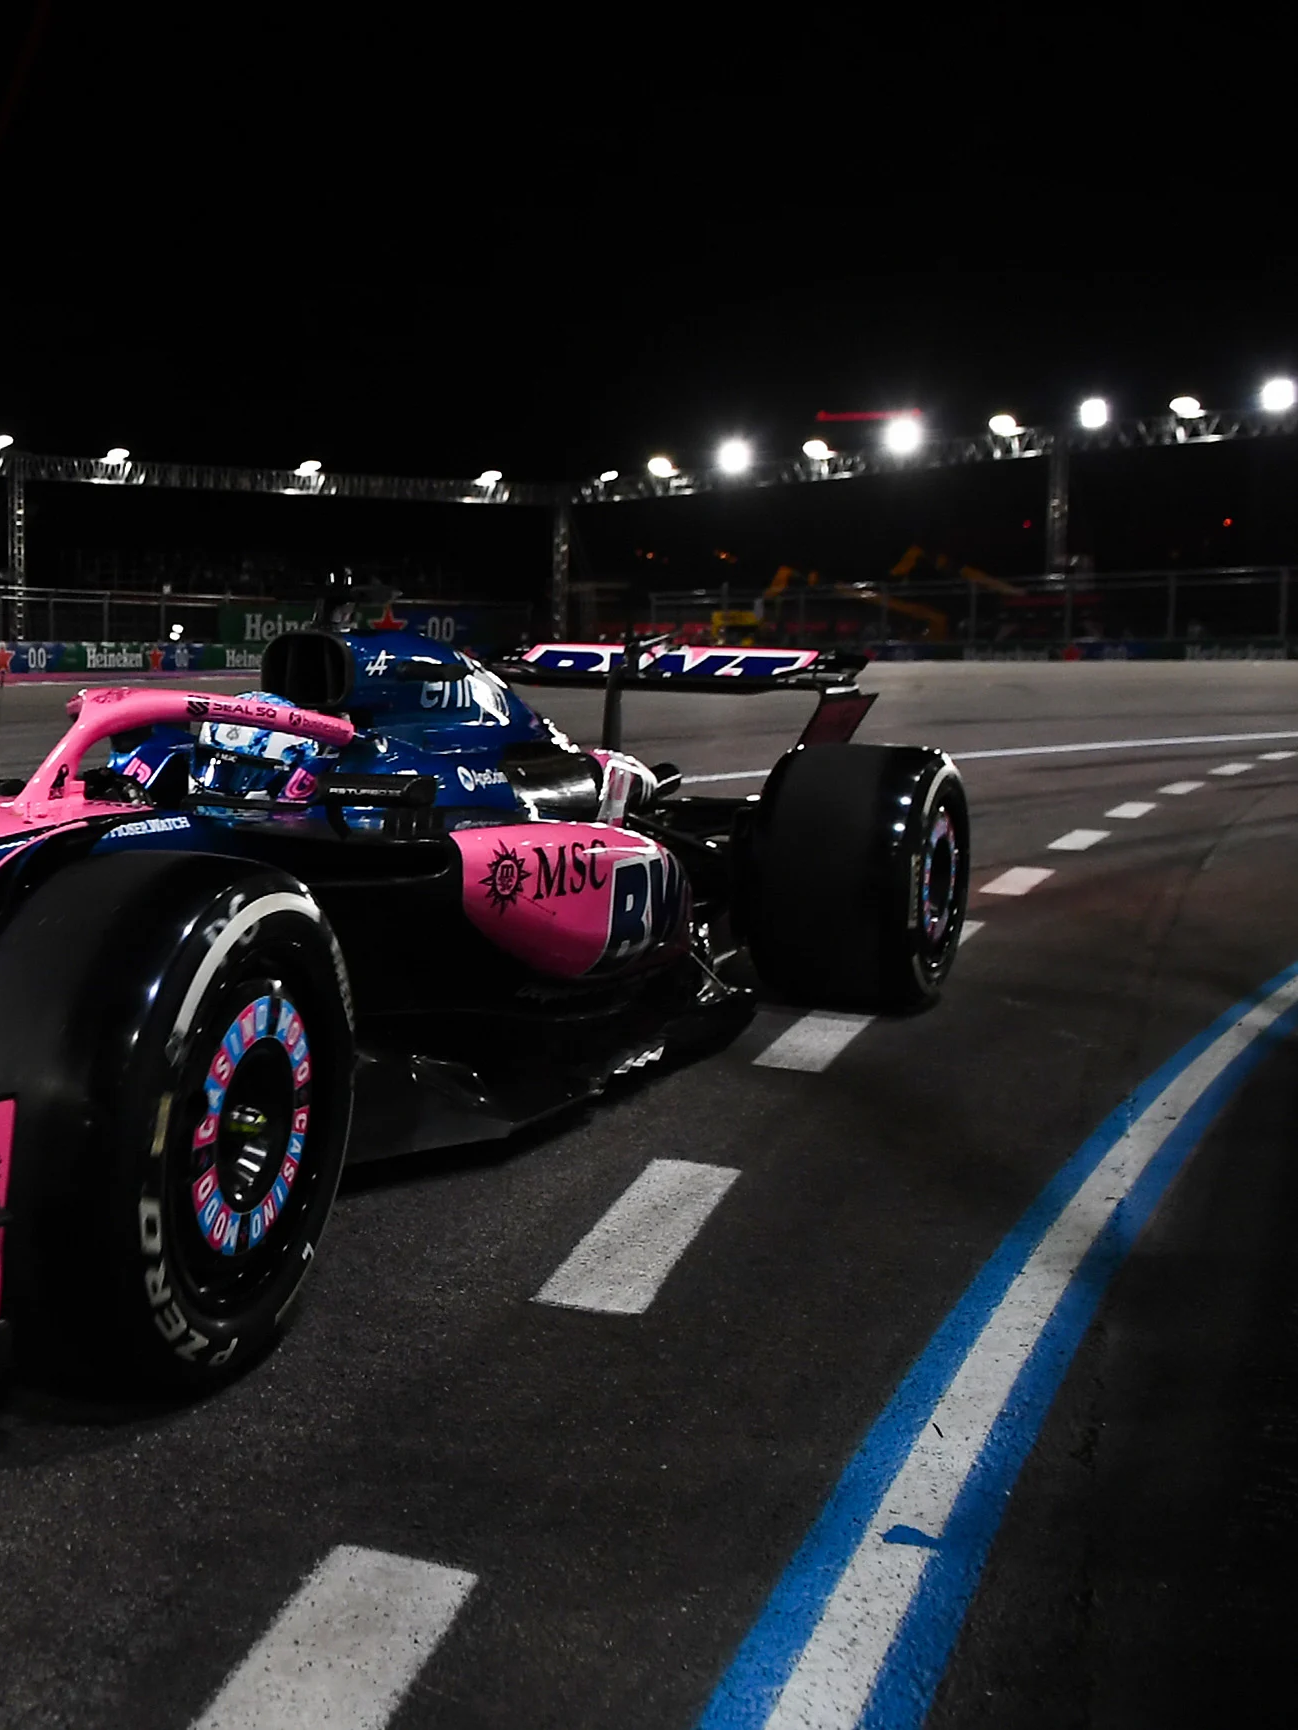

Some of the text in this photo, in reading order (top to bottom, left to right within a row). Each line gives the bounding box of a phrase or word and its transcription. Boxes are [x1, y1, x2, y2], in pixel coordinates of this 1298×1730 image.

[86, 647, 144, 669] Heineken
[532, 839, 608, 900] MSC
[138, 1197, 210, 1362] ZERO
